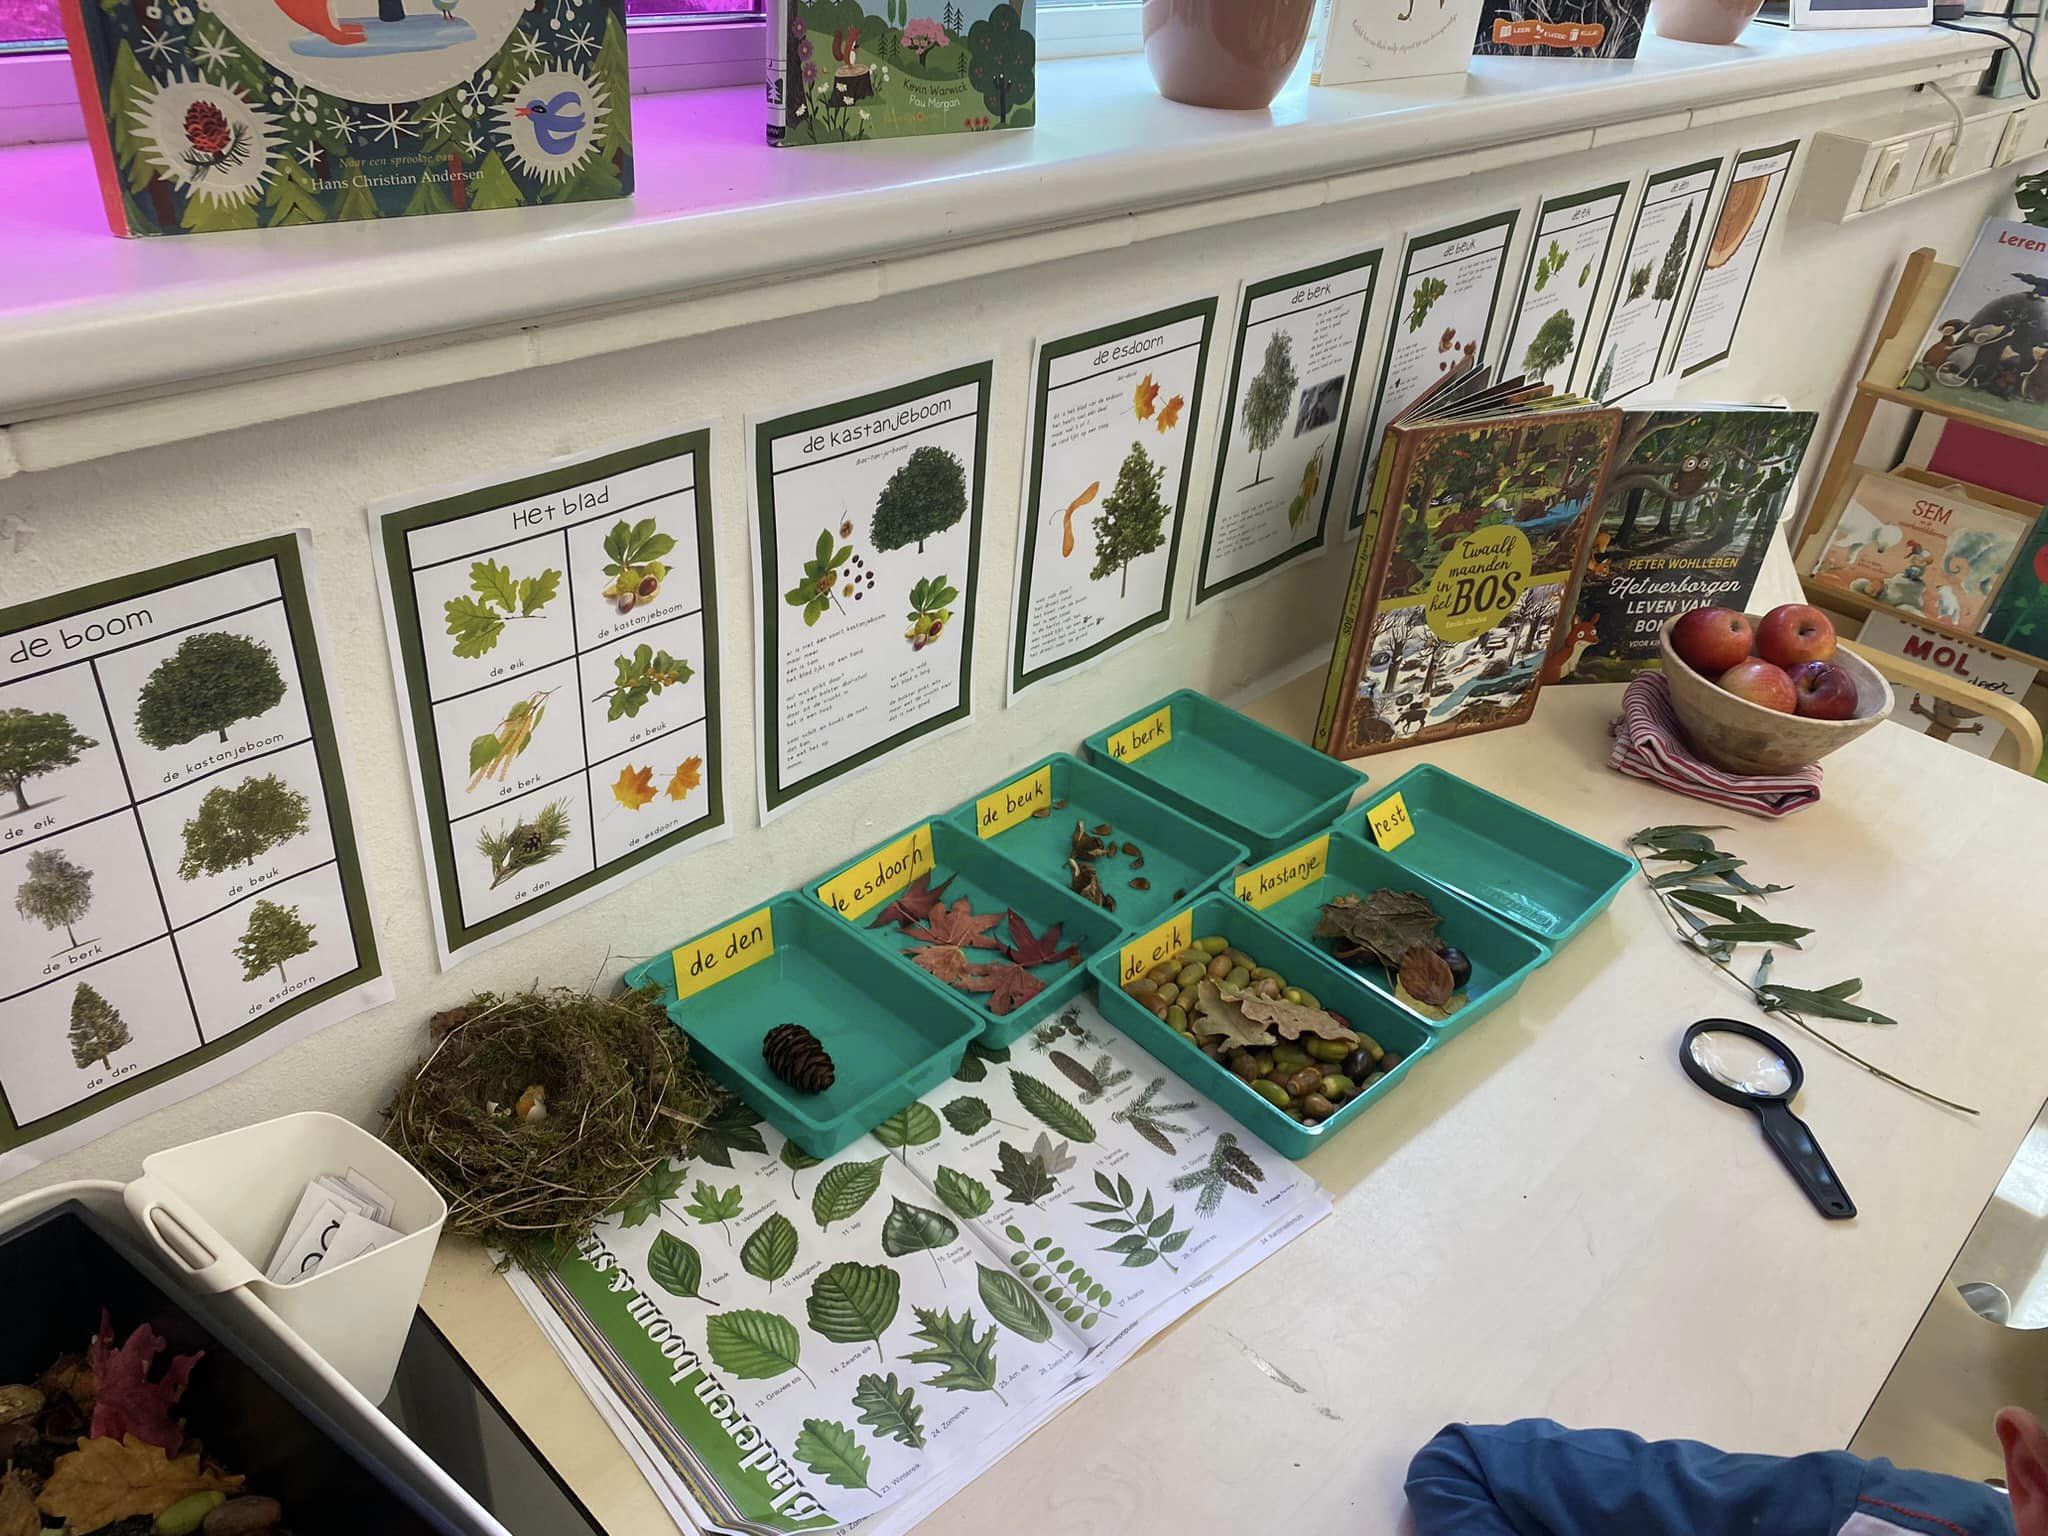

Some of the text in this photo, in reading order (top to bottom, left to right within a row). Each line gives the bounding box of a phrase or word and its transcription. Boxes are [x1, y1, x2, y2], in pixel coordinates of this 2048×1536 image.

[903, 78, 969, 96] Kevin Warwick
[909, 94, 961, 112] Pau Morgan
[339, 157, 366, 169] Naar
[369, 157, 387, 167] een
[435, 153, 455, 163] van
[311, 169, 485, 191] Hans Christian Andersen
[1443, 238, 1477, 258] de beuk
[1998, 230, 2047, 253] Leren
[1291, 283, 1332, 305] de berk
[1093, 335, 1165, 367] de esdoorn
[802, 398, 952, 454] de kastanjeboom
[512, 485, 610, 530] Het blad
[1912, 499, 1953, 525] SEM
[1462, 535, 1517, 560] Twaalf
[1448, 555, 1513, 578] maanden
[1628, 557, 1739, 571] PETER WOHLLEBEN
[1436, 580, 1453, 593] in
[1447, 571, 1523, 617] BOS
[1608, 575, 1742, 599] Het verborgen
[1429, 593, 1452, 612] het
[1626, 599, 1712, 615] LEVEN VAN
[597, 603, 684, 640] de kastanjeboom
[9, 608, 154, 664] de boom
[1629, 640, 1650, 648] VOOR
[1903, 634, 1970, 676] MOL
[490, 659, 527, 678] de eik
[629, 721, 669, 744] de beuk
[1112, 718, 1165, 758] de berk
[162, 733, 285, 784] de kastanjeboom
[499, 773, 542, 797] de berk
[982, 780, 1044, 827] de beuk
[4, 814, 57, 841] de eik
[628, 818, 680, 848] de esdoorn
[1373, 806, 1406, 838] rest
[228, 867, 281, 898] de beuk
[514, 879, 551, 901] de den
[1238, 855, 1321, 903] de kastanje
[42, 944, 104, 976] de berk
[689, 924, 764, 978] de den
[1124, 926, 1183, 981] de eik
[248, 975, 317, 1015] de esdoorn
[86, 1062, 138, 1090] de den
[712, 1271, 730, 1285] Beuk
[626, 1290, 702, 1387] boom
[830, 1365, 841, 1376] 14.
[841, 1353, 862, 1369] Zwarte
[755, 1398, 765, 1409] 13.
[931, 1426, 943, 1439] 24.
[694, 1371, 829, 1522] Bladeren
